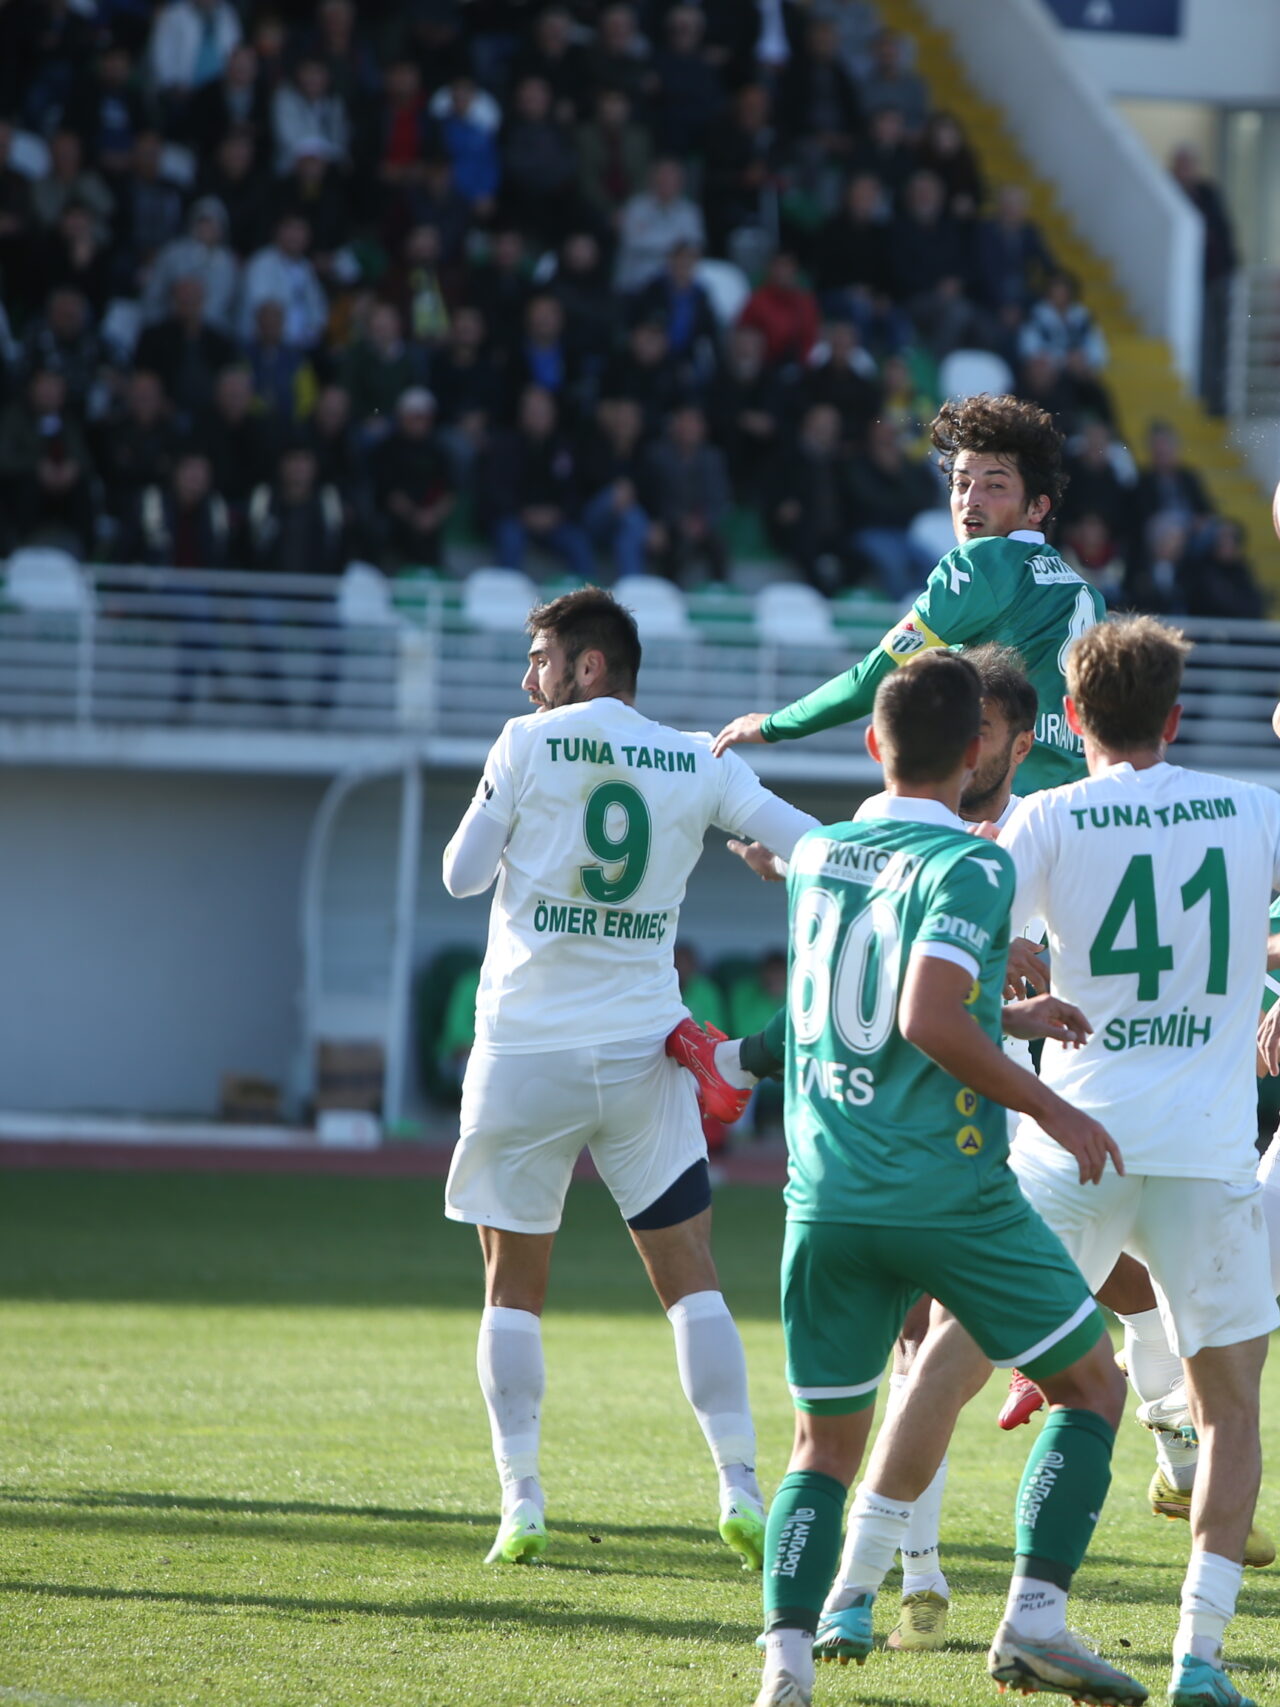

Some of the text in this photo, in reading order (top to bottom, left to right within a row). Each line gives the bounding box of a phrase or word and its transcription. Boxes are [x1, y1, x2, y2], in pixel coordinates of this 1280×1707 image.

[546, 737, 696, 774] TUNA TARIM
[580, 779, 652, 905] 9
[1070, 797, 1237, 830] TUNA TARIM
[534, 900, 668, 944] ÖMER ERMEÇ
[1089, 847, 1230, 1001] 41
[790, 886, 901, 1056] 80
